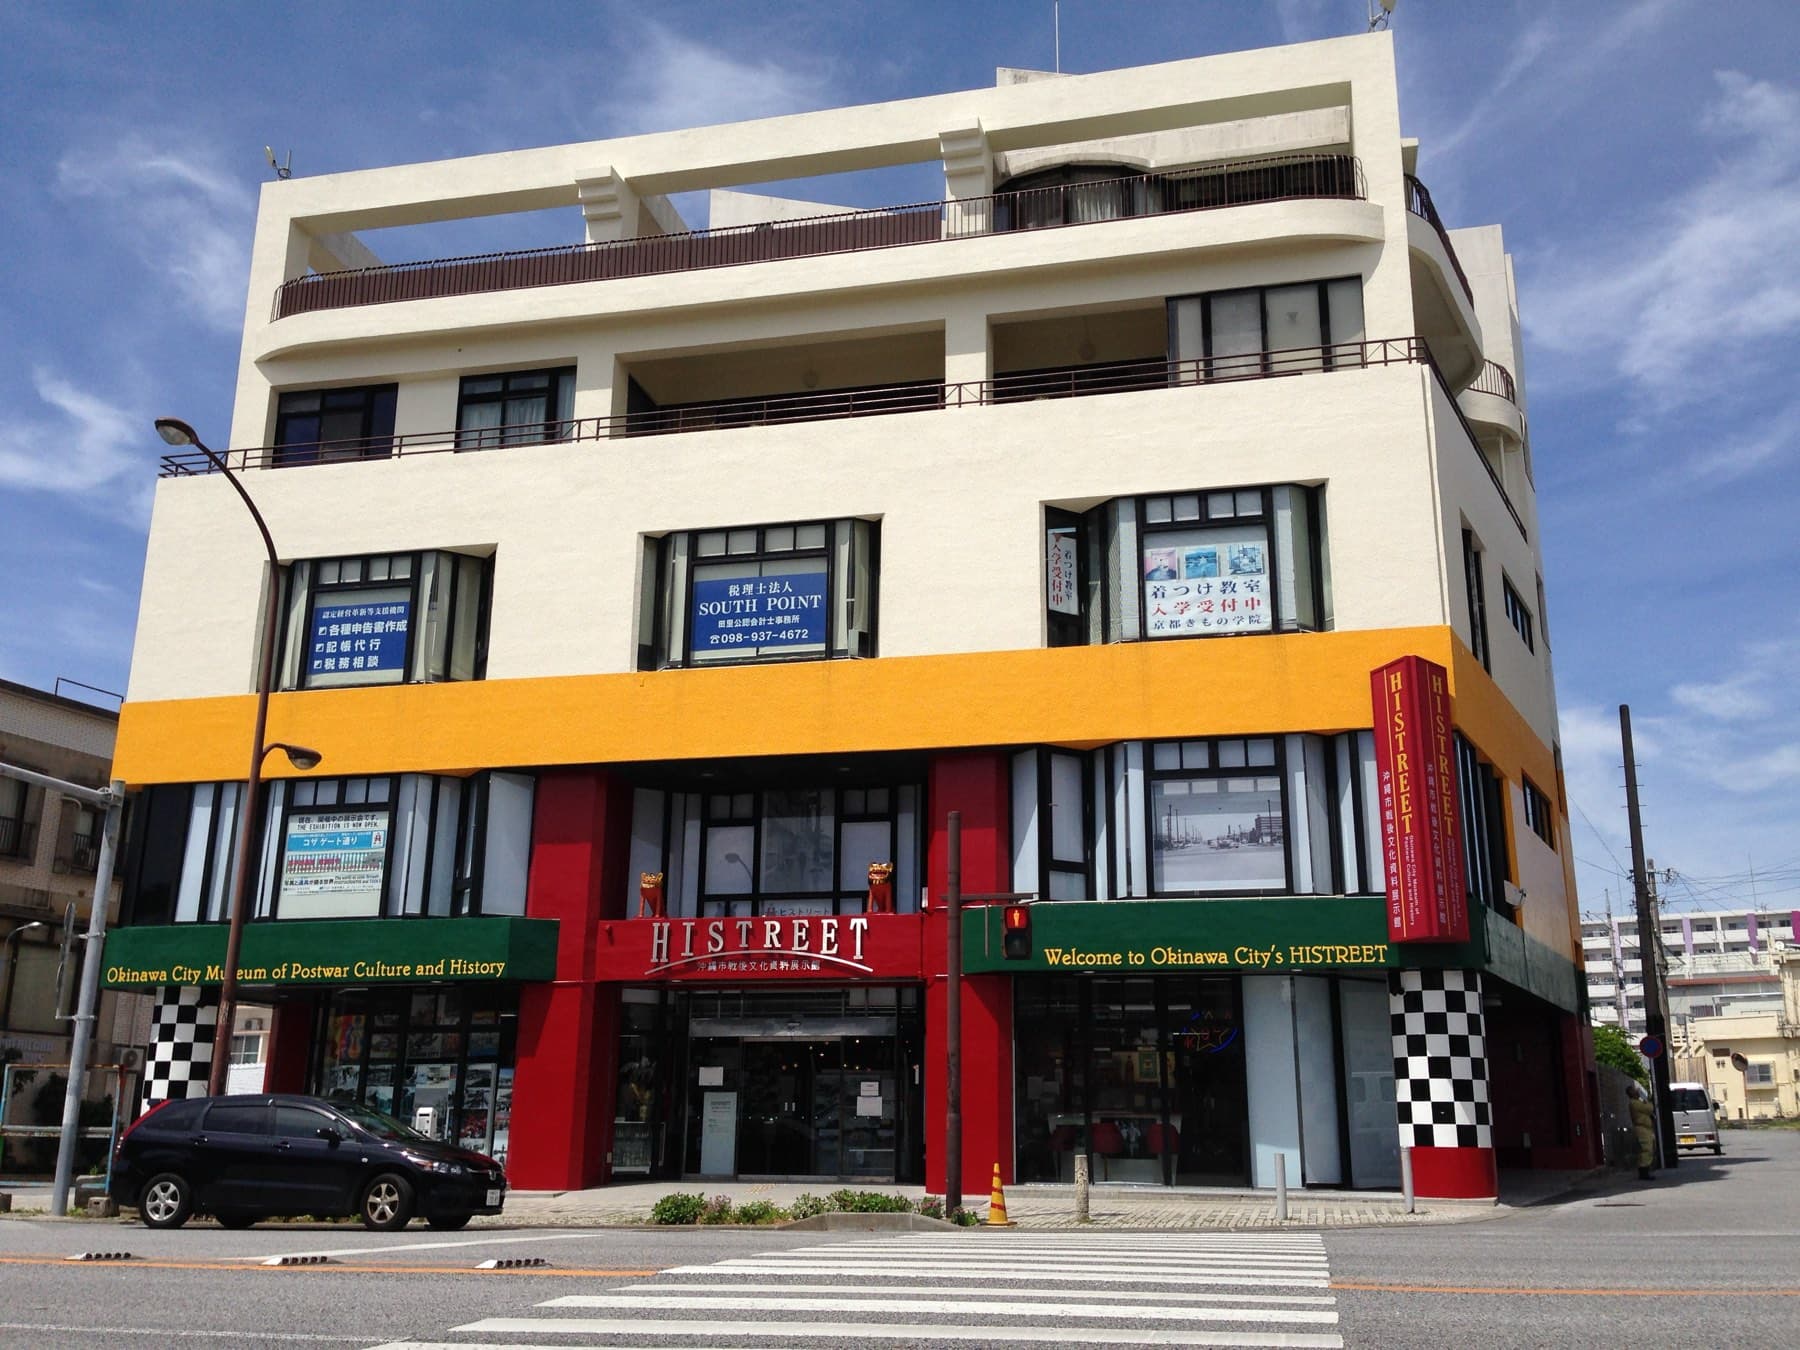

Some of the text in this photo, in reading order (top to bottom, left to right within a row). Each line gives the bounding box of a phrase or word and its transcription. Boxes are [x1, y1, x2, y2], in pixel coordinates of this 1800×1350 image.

[727, 581, 793, 597] 税理士法人
[1151, 579, 1261, 600] 着つけ教室
[698, 594, 822, 616] SOUTH POINT
[1151, 597, 1261, 617] 入学受付中
[329, 620, 408, 636] 各種申告書作成
[1153, 615, 1262, 630] 京都きもの学院
[721, 628, 809, 644] 098-937-4672
[324, 655, 379, 670] 税務相談
[1390, 671, 1412, 834] HISTREET
[1432, 674, 1453, 837] HISTREET
[651, 918, 868, 963] HISTREET
[1044, 944, 1389, 968] Welcome to Okinawa City's HISTREET
[106, 958, 506, 985] Okinawa City Mueum of Postwar Culture and History
